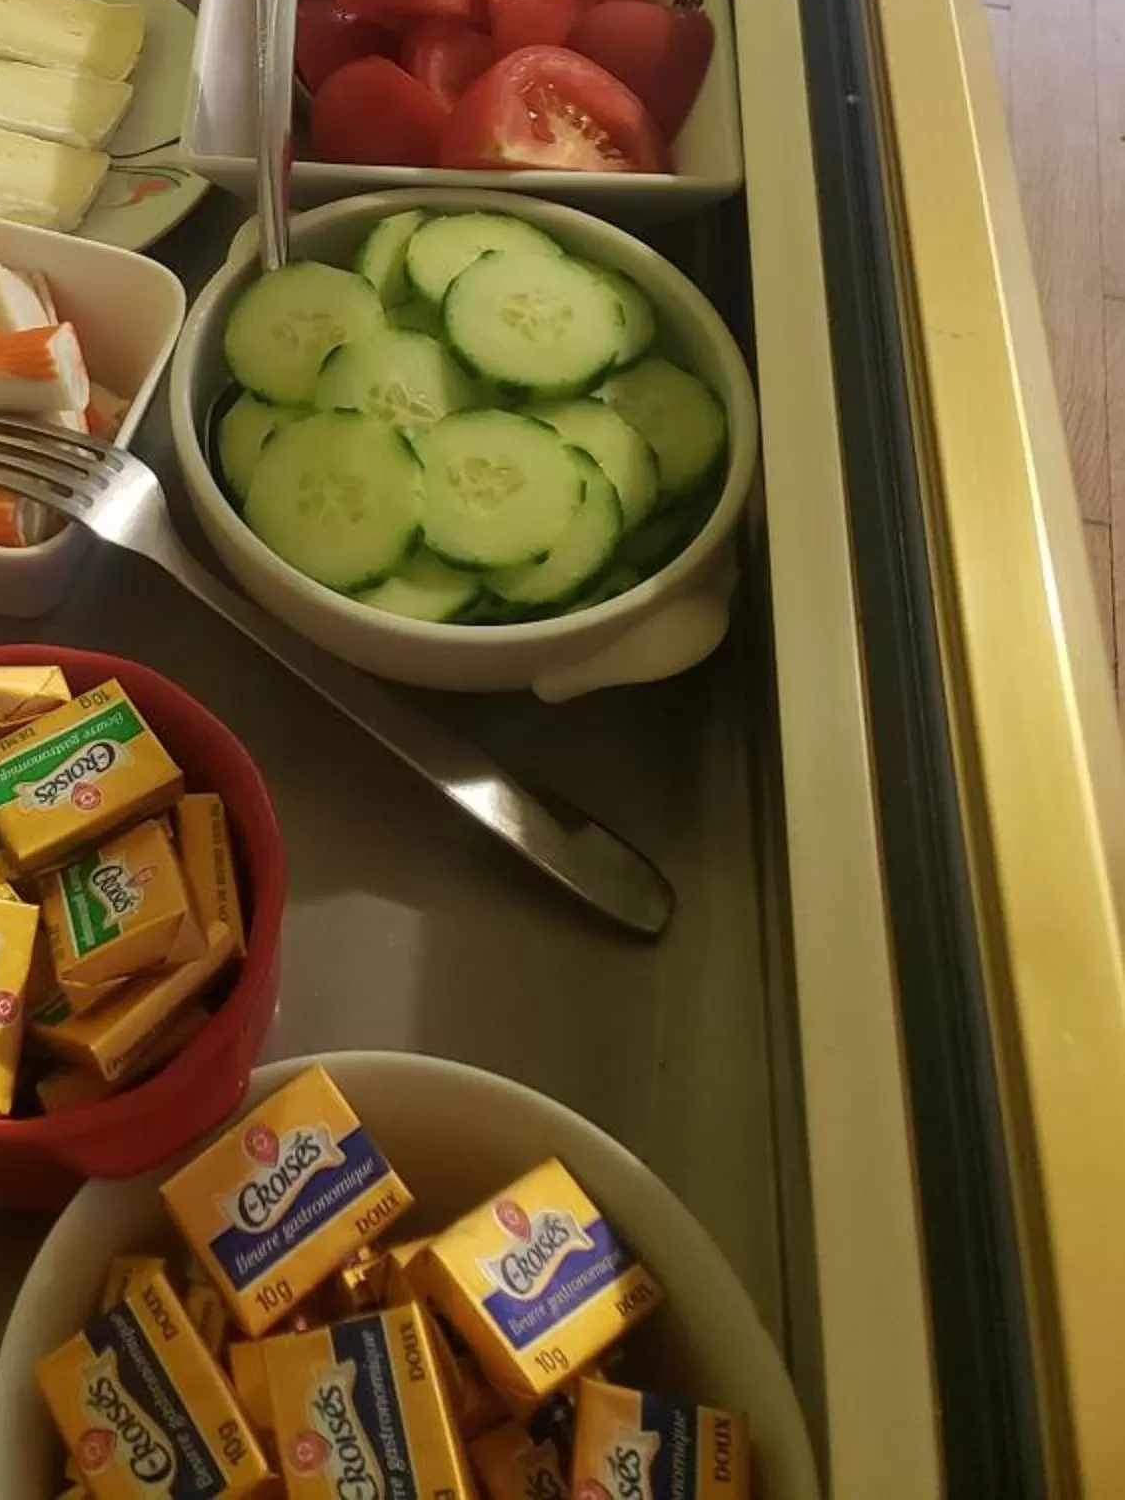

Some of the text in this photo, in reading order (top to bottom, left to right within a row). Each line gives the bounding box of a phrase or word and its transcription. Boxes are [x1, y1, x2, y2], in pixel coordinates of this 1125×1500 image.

[234, 1156, 375, 1277] Beurre gastronomique
[237, 1130, 323, 1229] Croisés
[254, 1189, 401, 1313] 10g DOUX
[142, 1283, 248, 1468] 10g DOUX
[400, 1321, 426, 1382] DOUX
[534, 1347, 570, 1375] 10g
[713, 1417, 733, 1484] DOUX
